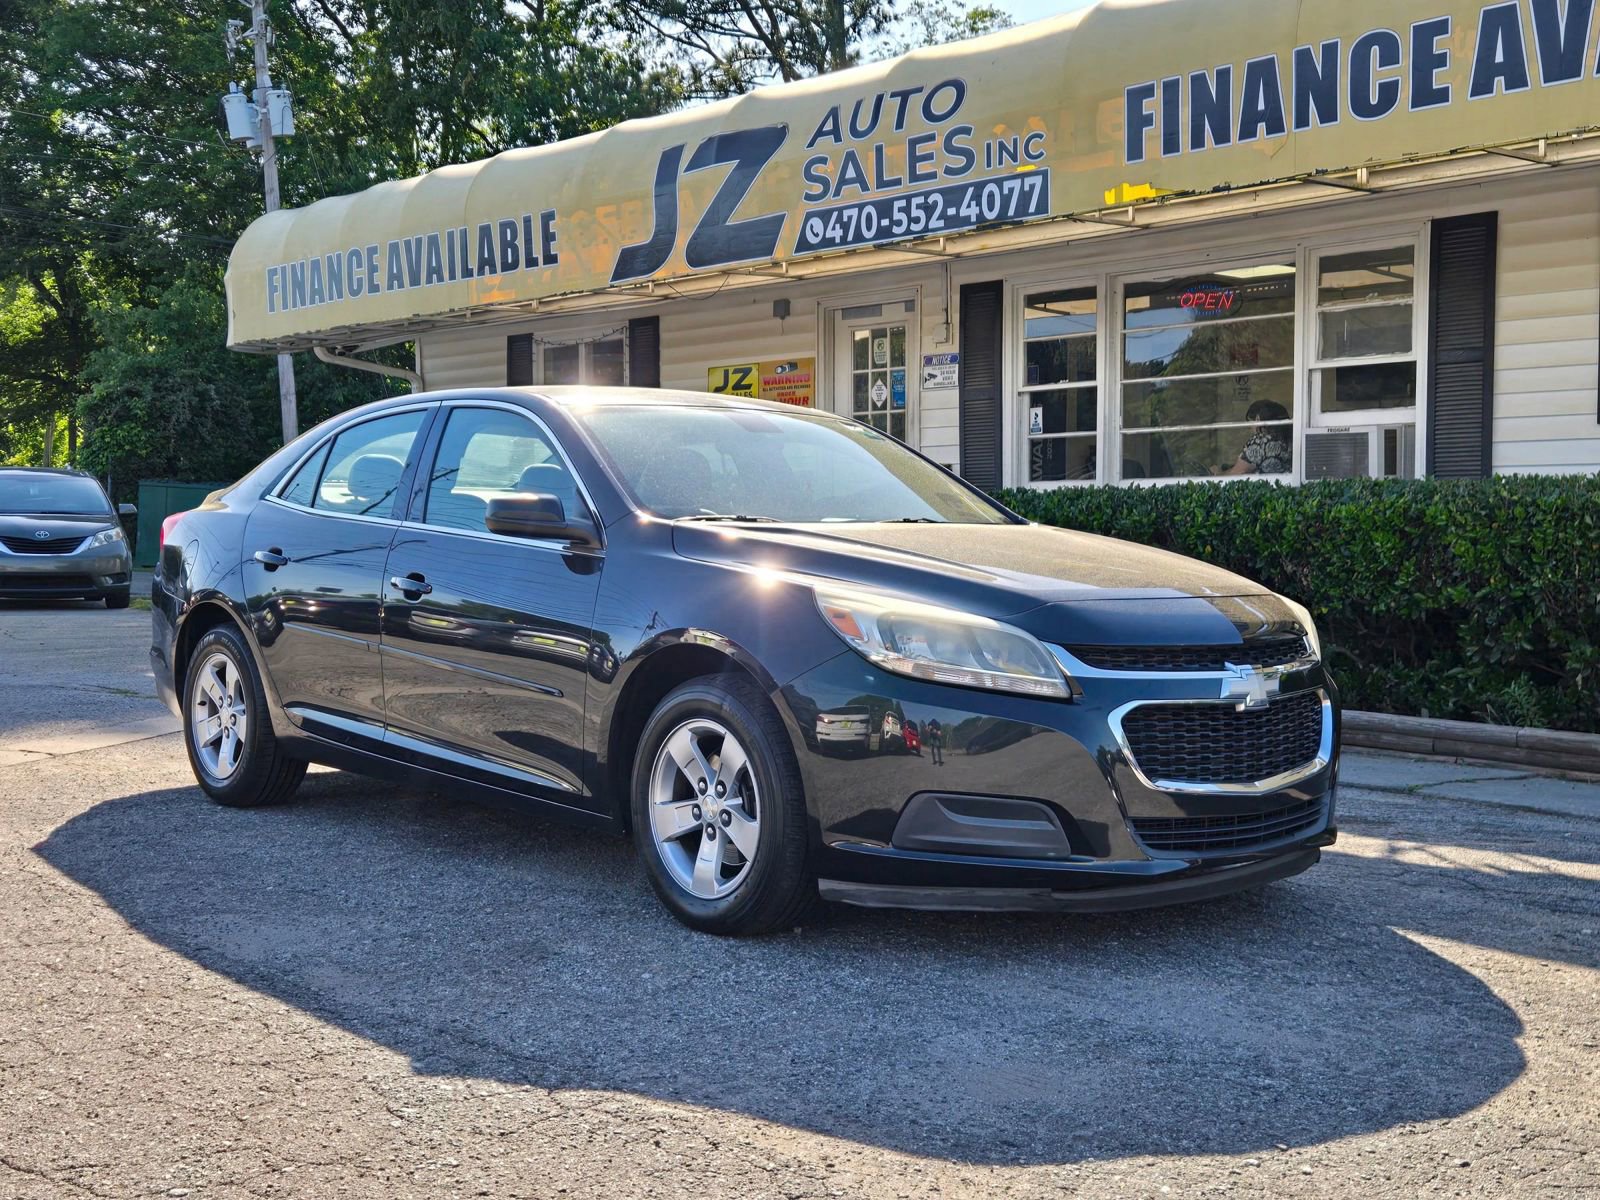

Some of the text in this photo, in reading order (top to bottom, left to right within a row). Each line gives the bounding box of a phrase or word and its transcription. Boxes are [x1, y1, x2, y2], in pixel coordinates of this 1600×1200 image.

[803, 77, 967, 151] AUTO
[1124, 0, 1600, 165] FINANCE AV
[802, 124, 1047, 205] SALES INC
[609, 122, 790, 285] JZ
[825, 174, 1044, 245] 470-552-4077
[265, 244, 381, 314] FINANCE
[386, 208, 560, 293] AVAILABLE
[1180, 291, 1234, 310] OPEN
[713, 367, 753, 393] JZ
[763, 374, 810, 386] WARNING
[931, 355, 952, 365] NOTICE
